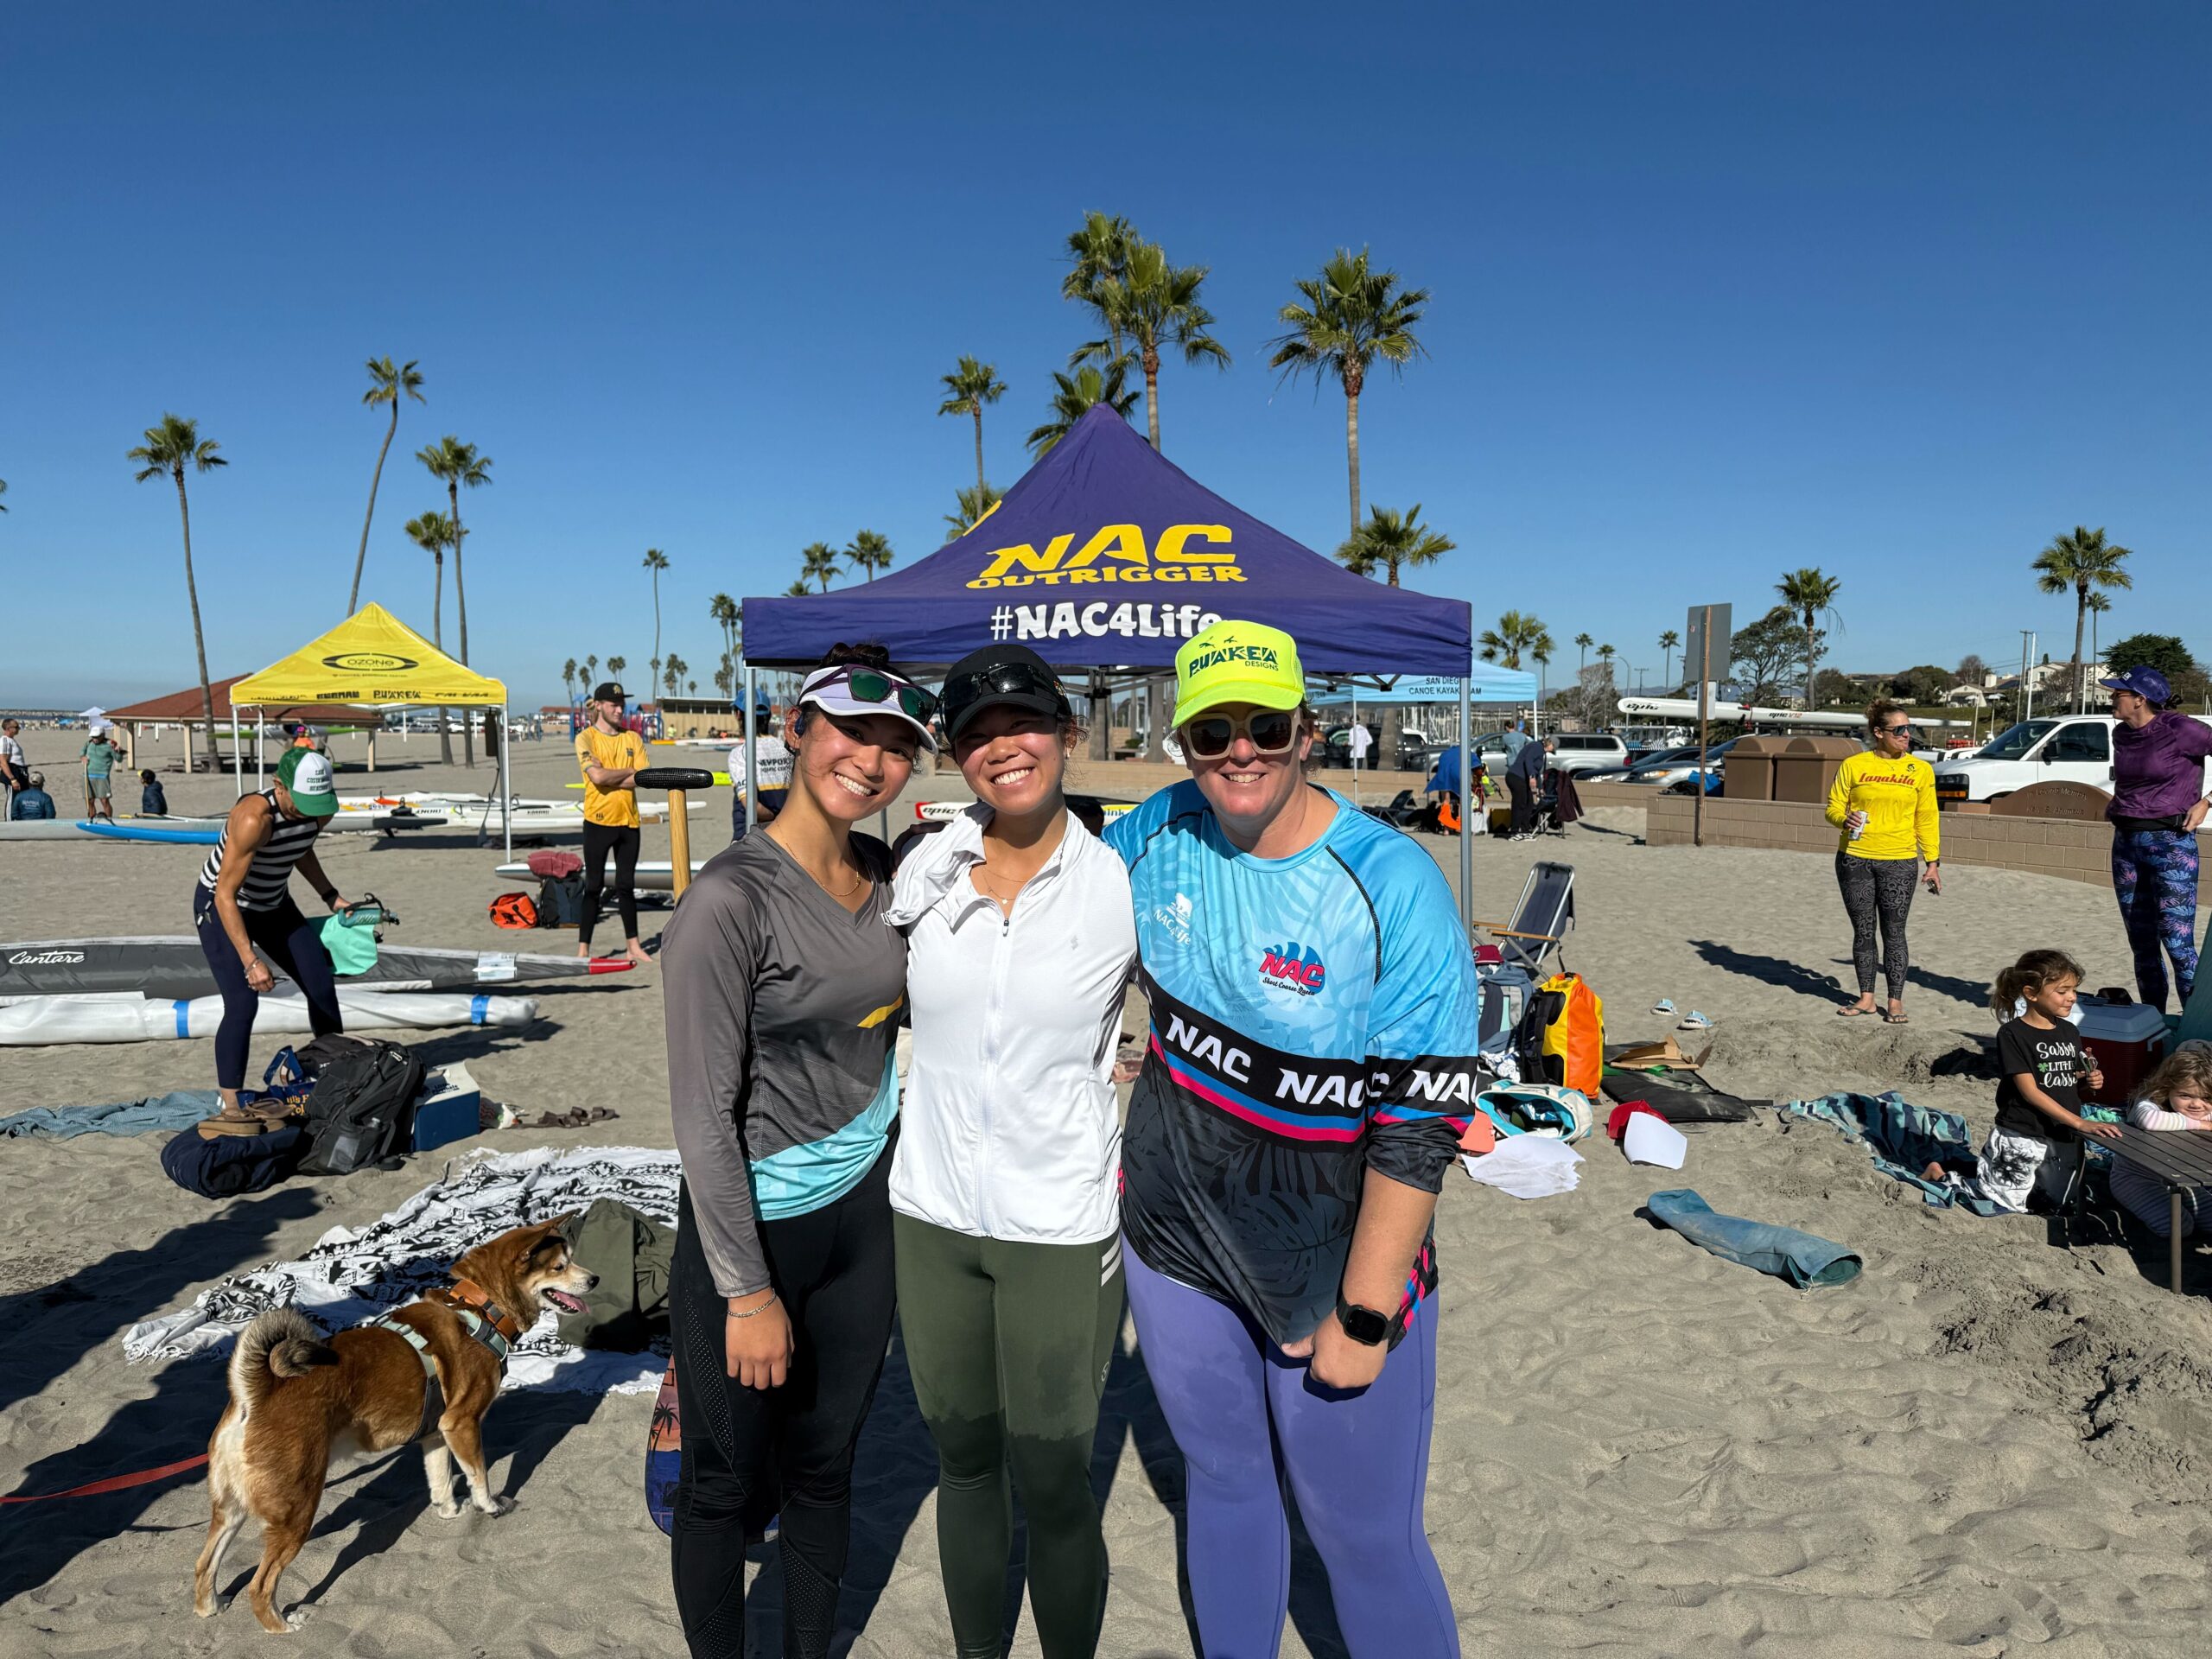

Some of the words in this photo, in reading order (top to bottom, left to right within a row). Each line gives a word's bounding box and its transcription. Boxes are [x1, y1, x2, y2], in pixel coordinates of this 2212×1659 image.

[979, 524, 1236, 578] NAC
[965, 566, 1249, 589] OUTRIGGER
[1189, 645, 1279, 678] PUAKEA
[1244, 660, 1279, 671] DESIGNS
[923, 807, 957, 816] epic
[1104, 808, 1124, 817] ink
[9, 950, 86, 964] Cantare
[1258, 951, 1325, 988] NAC
[1262, 976, 1279, 987] Short
[1279, 982, 1297, 992] Course
[1297, 986, 1315, 996] Queen
[1166, 1012, 1252, 1084] NAC
[2036, 1041, 2075, 1059] Sassy
[1405, 1069, 1478, 1106] NA
